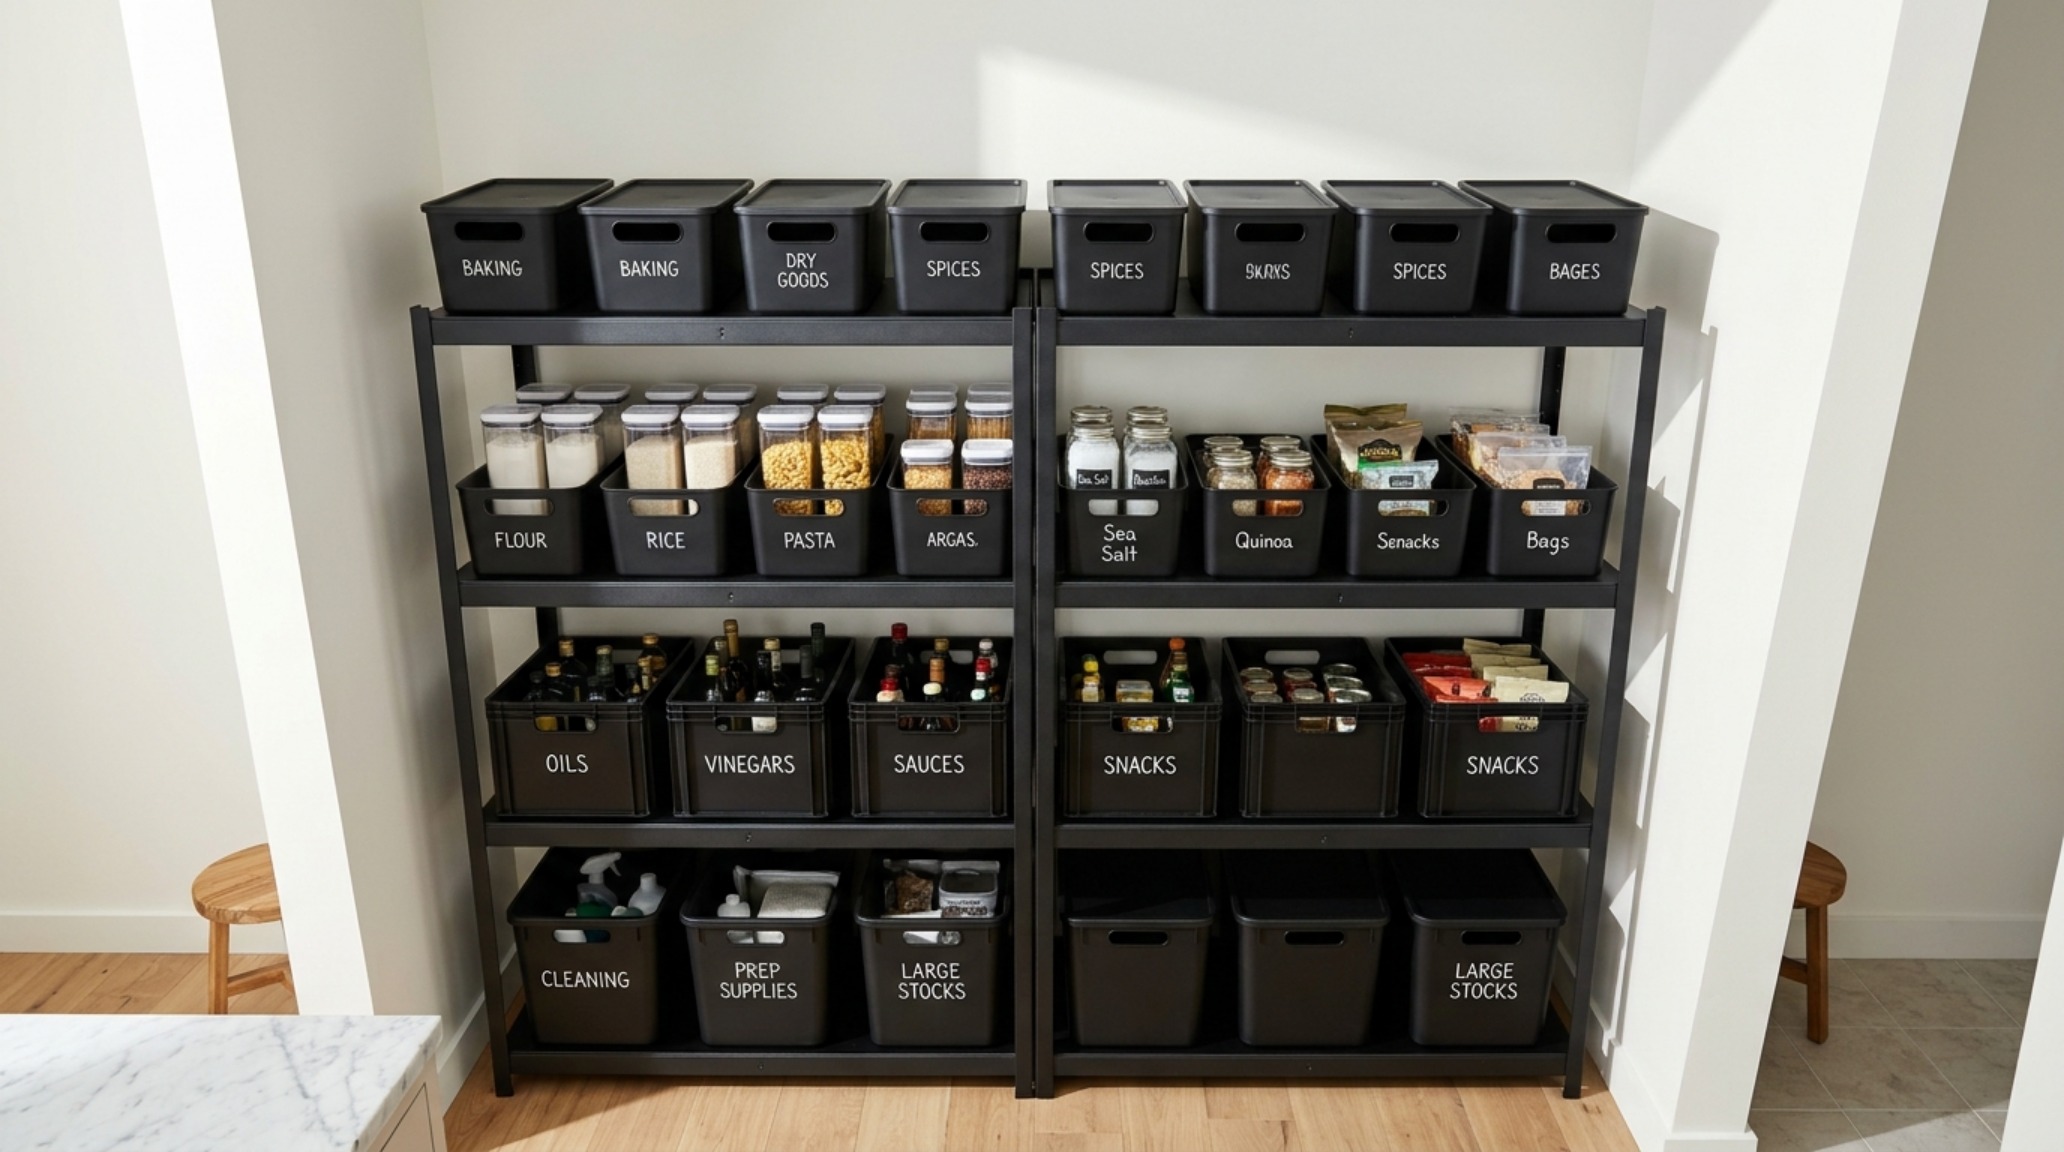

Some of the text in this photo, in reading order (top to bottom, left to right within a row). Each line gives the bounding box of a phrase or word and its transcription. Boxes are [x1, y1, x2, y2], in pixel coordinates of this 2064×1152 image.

[462, 258, 523, 277] BAKING
[619, 259, 679, 277] BAKING
[785, 252, 817, 269] DRY
[926, 259, 981, 277] SPICES
[777, 271, 829, 289] GOODS
[1090, 261, 1144, 280] SPICES
[1393, 262, 1447, 280] SPICES
[1549, 262, 1600, 280] BAGES
[494, 531, 548, 549] FLOUR
[645, 530, 686, 549] RICE
[783, 531, 836, 550] PASTA
[1103, 523, 1137, 542] Sea
[1235, 530, 1294, 550] Quinoa
[1526, 530, 1570, 556] Bags
[1101, 544, 1138, 562] Salt
[545, 753, 589, 774] OILS
[704, 754, 796, 774] VINEGARS
[893, 753, 965, 774] SAUCES
[1103, 755, 1177, 775] SNACKS
[1466, 755, 1539, 775] SNACKS
[541, 969, 630, 989] CLEANING
[734, 961, 781, 979] PREP
[901, 962, 961, 980] LARGE
[1455, 962, 1514, 980] LARGE
[719, 981, 798, 1000] SUPPLIES
[898, 981, 966, 1000] STOCKS
[1449, 981, 1518, 1000] STOCKS
